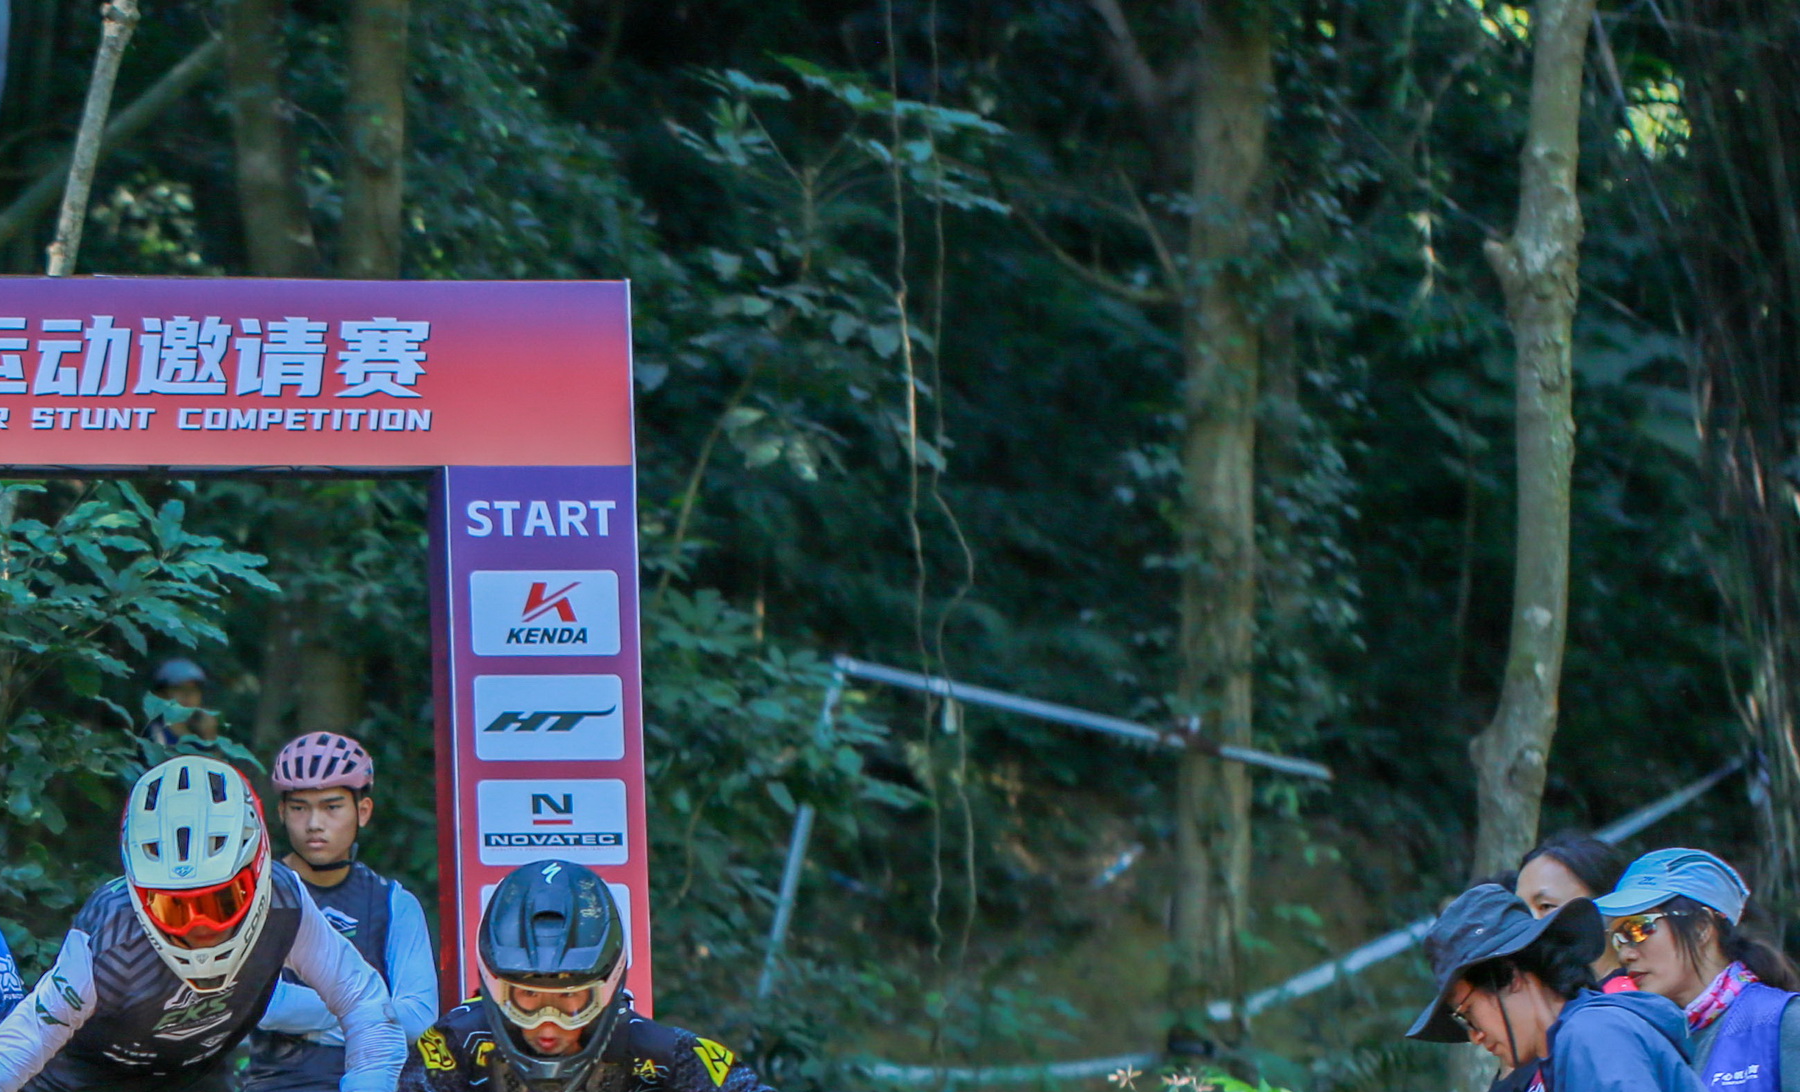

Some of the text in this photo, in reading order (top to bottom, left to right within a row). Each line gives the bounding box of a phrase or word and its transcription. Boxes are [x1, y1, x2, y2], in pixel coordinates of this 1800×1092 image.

[31, 407, 155, 430] STUNT
[177, 407, 432, 431] COMPETITION
[466, 500, 617, 537] START
[506, 627, 588, 645] KENDA
[483, 704, 617, 733] HT
[491, 834, 615, 846] NOVATEC
